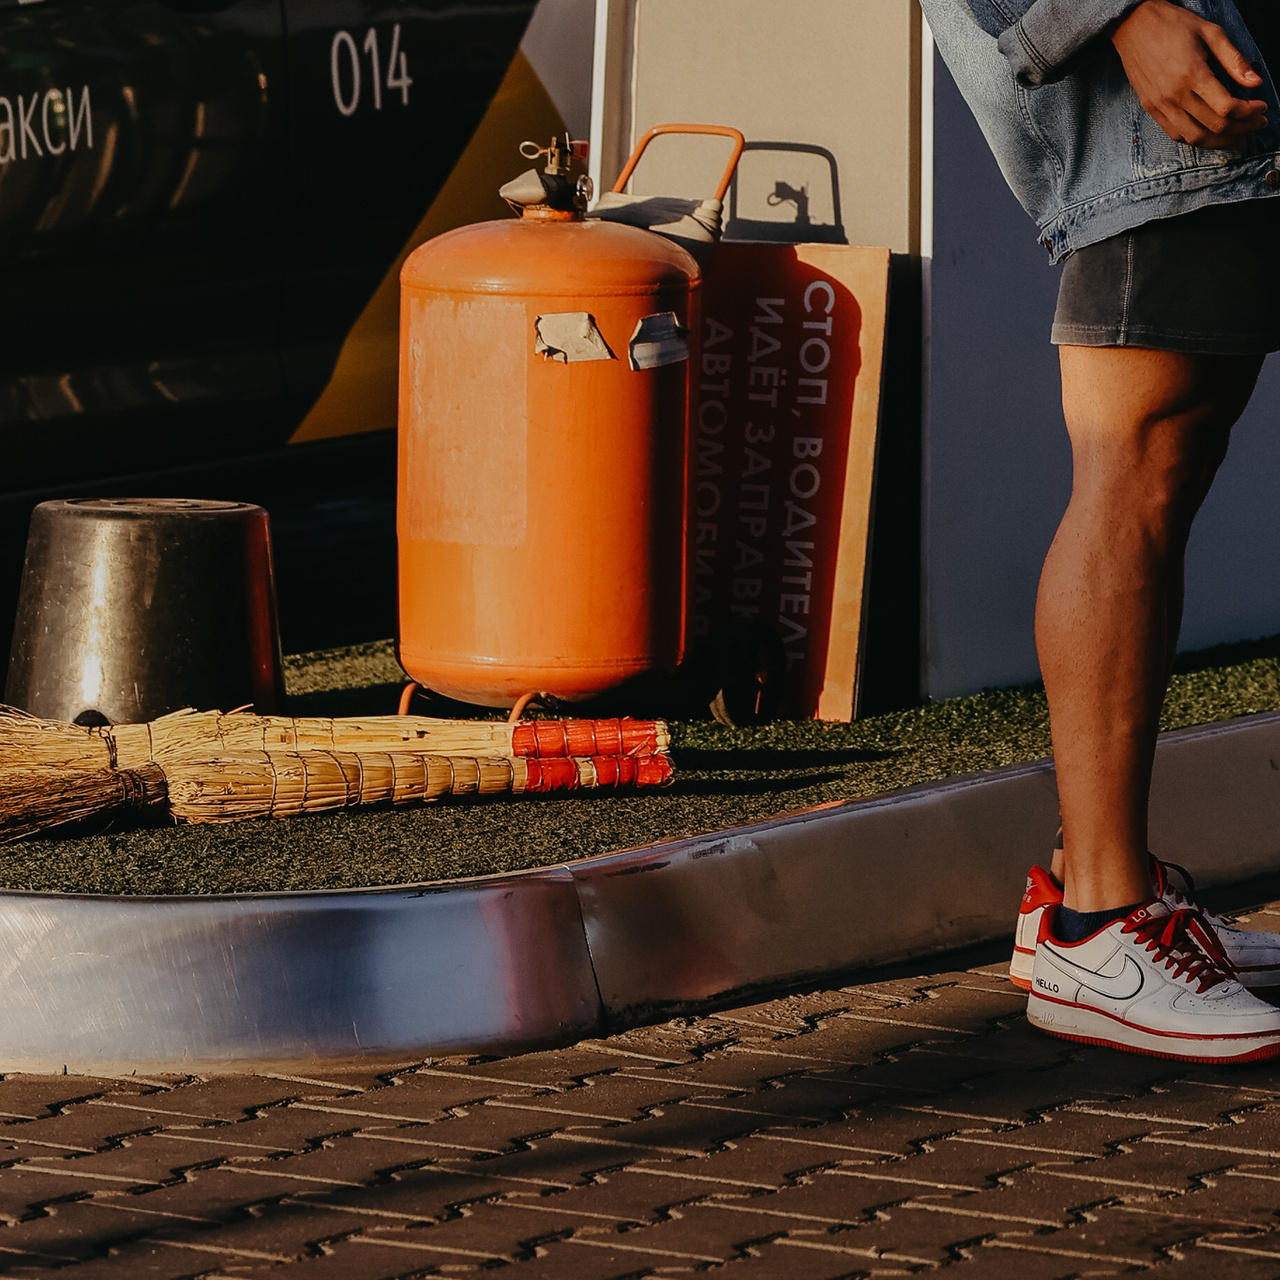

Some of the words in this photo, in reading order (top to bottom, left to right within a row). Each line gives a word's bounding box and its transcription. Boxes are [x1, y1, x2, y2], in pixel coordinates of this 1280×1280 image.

[330, 23, 414, 118] 014
[0, 84, 94, 164] акси
[748, 297, 787, 409] ИДЁТ
[792, 280, 836, 418] СТОП,
[730, 421, 776, 620] ЗАПРАВК
[1036, 977, 1059, 993] HELLO
